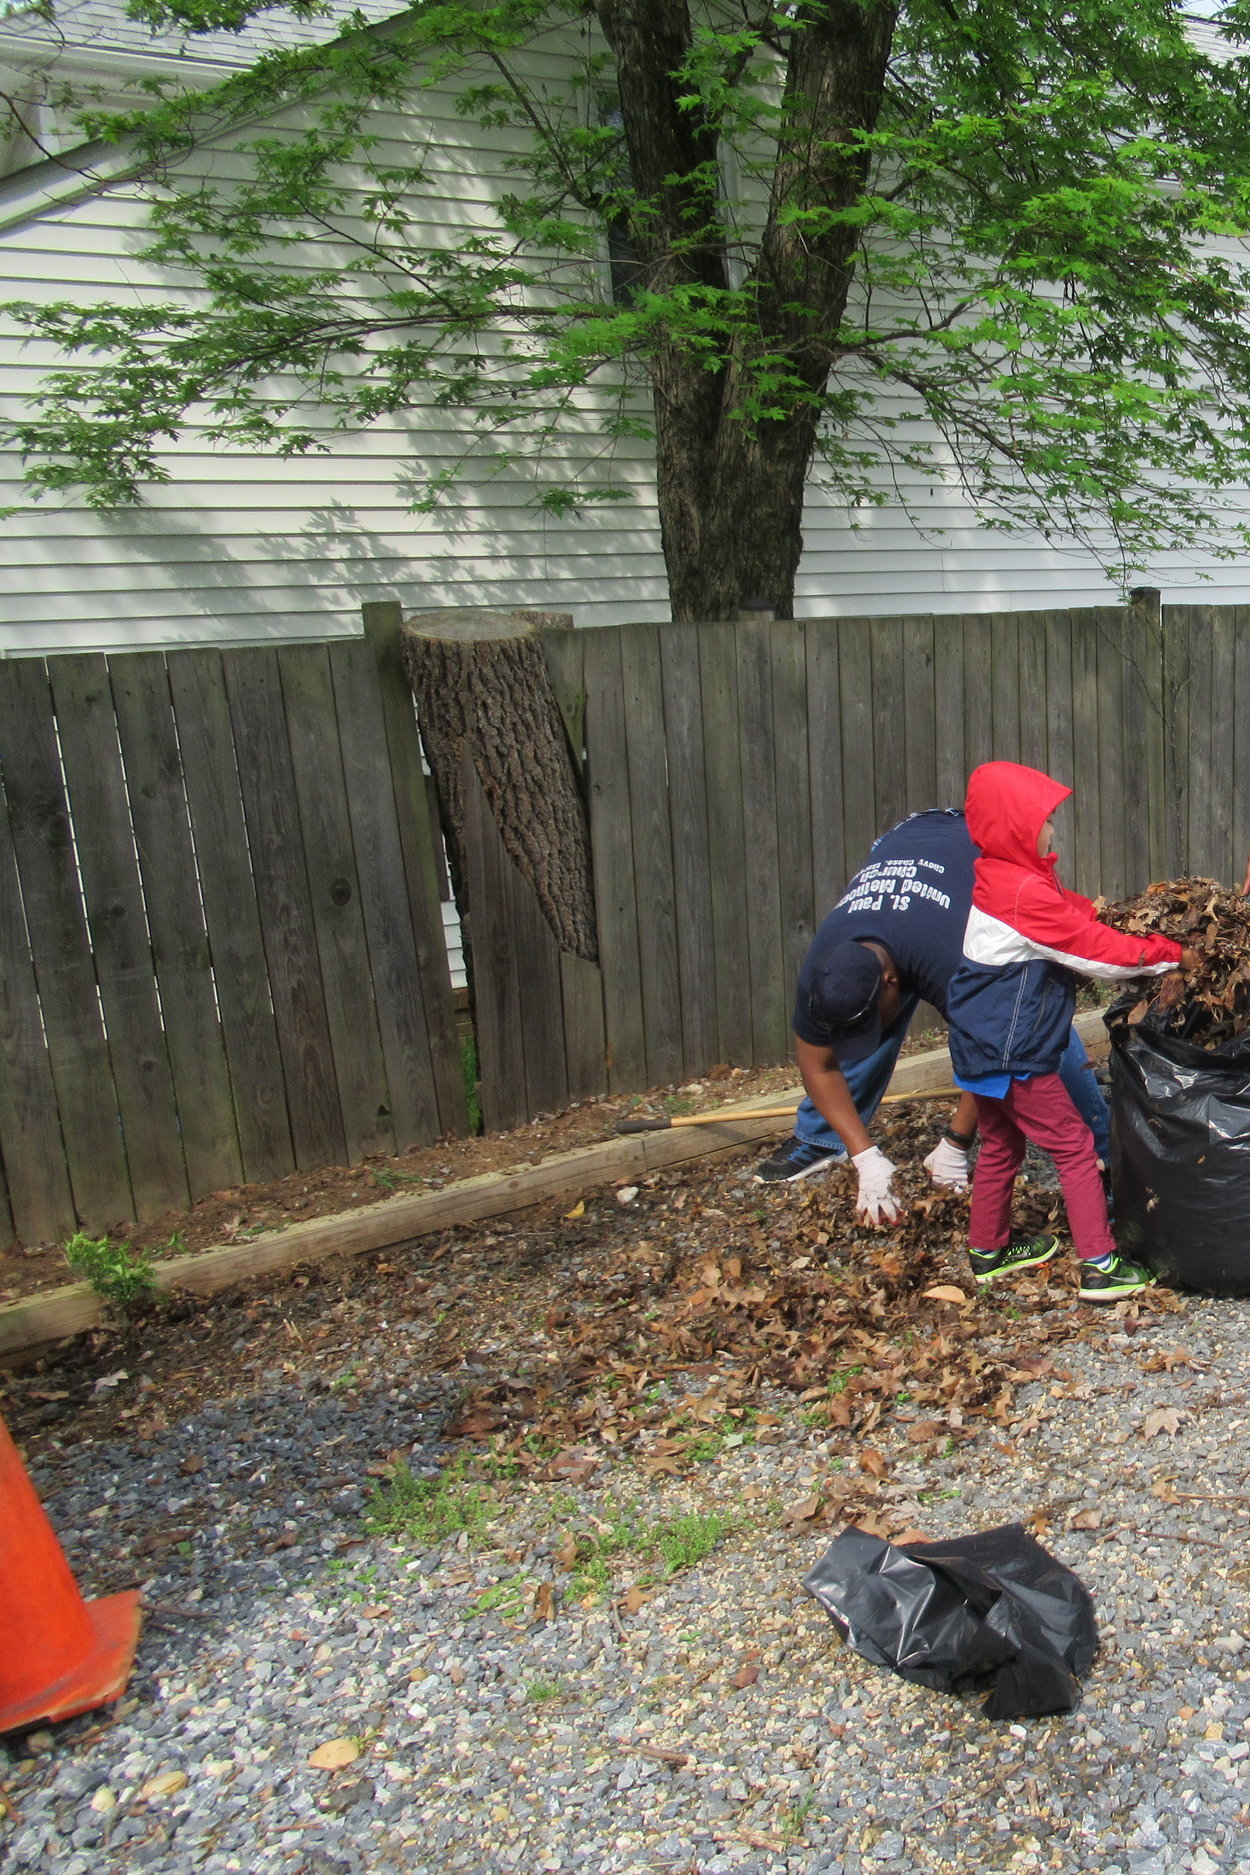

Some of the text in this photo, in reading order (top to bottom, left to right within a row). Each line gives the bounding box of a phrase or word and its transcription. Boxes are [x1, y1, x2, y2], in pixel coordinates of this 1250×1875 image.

[859, 865, 917, 883] Church
[917, 859, 945, 874] Chevy
[900, 879, 951, 909] United
[847, 894, 911, 913] St. Paul
